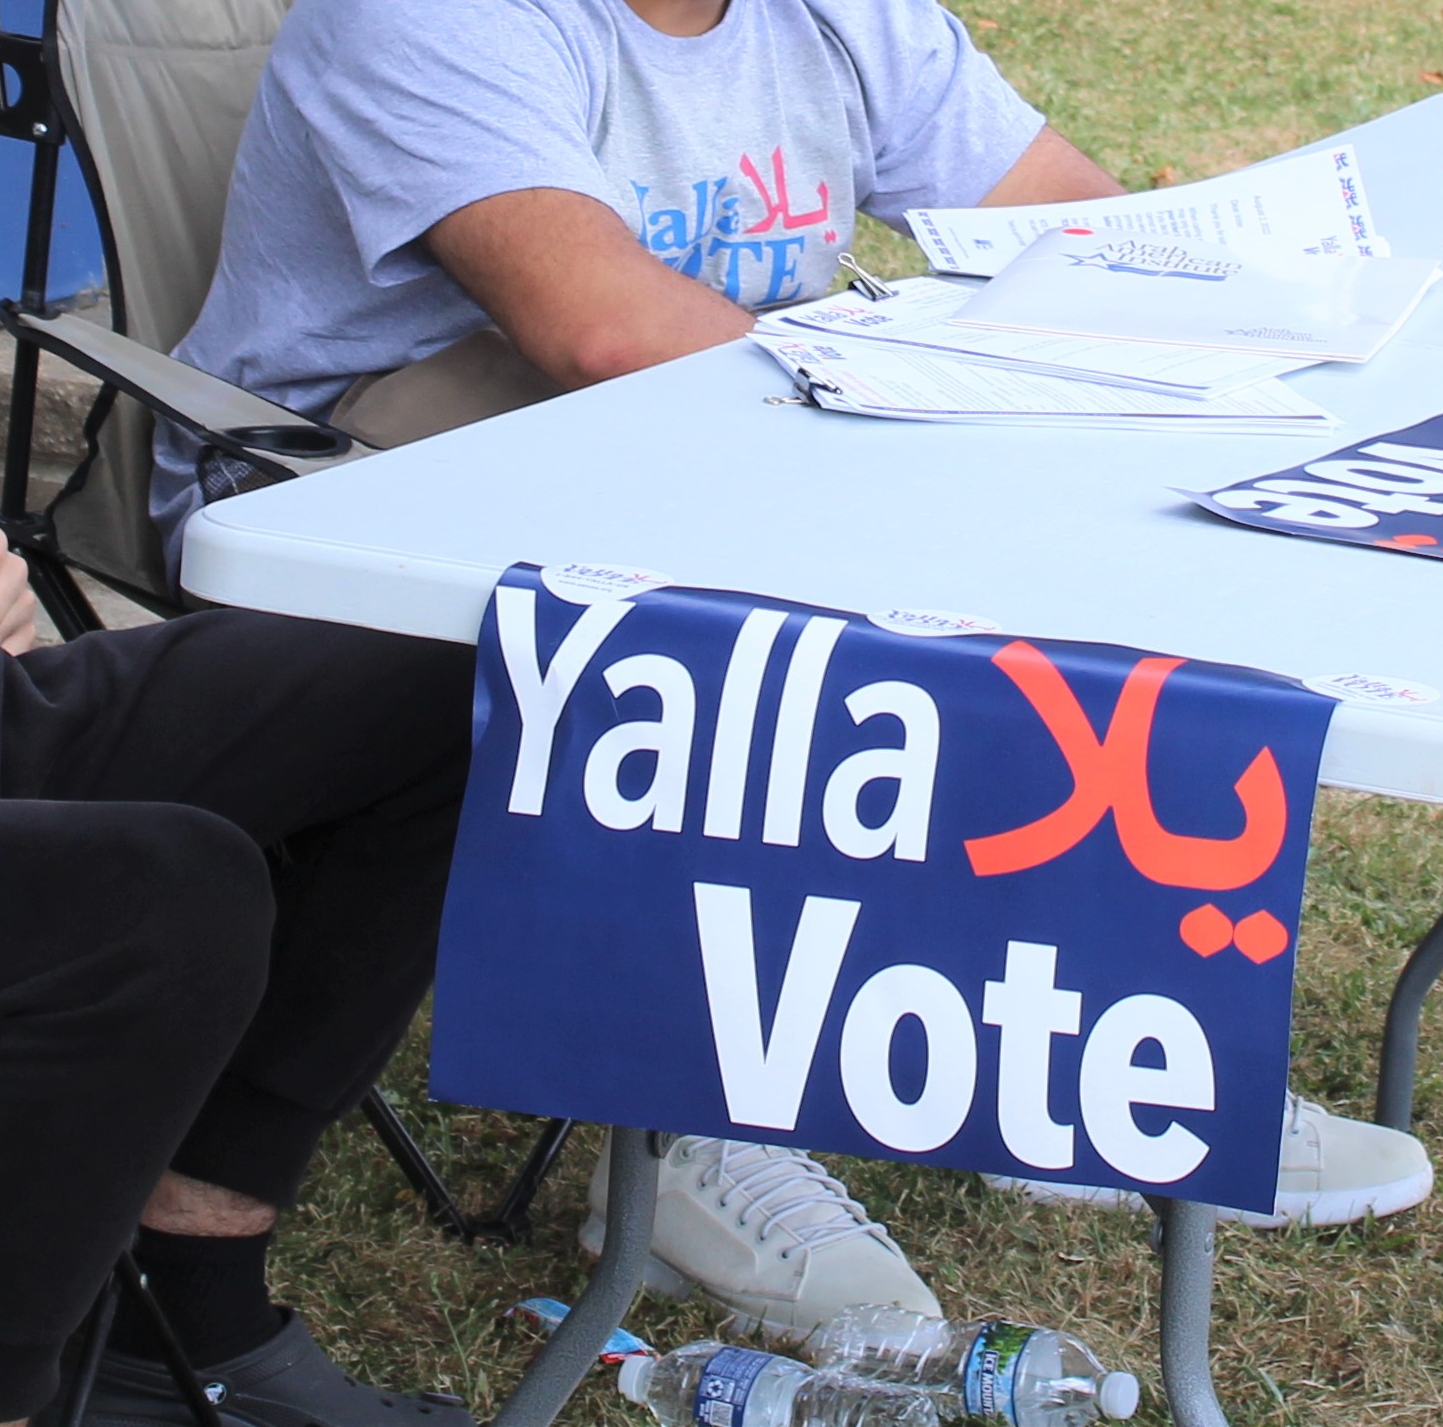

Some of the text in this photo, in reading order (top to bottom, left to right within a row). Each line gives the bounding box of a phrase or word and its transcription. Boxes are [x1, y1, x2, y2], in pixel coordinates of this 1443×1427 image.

[1095, 243, 1243, 270] American
[1118, 239, 1188, 256] Arab
[1118, 253, 1239, 276] Institute
[494, 585, 941, 863] Yalla
[963, 639, 1290, 965] يلا
[693, 881, 1217, 1184] Vote
[982, 1353, 997, 1372] ICE
